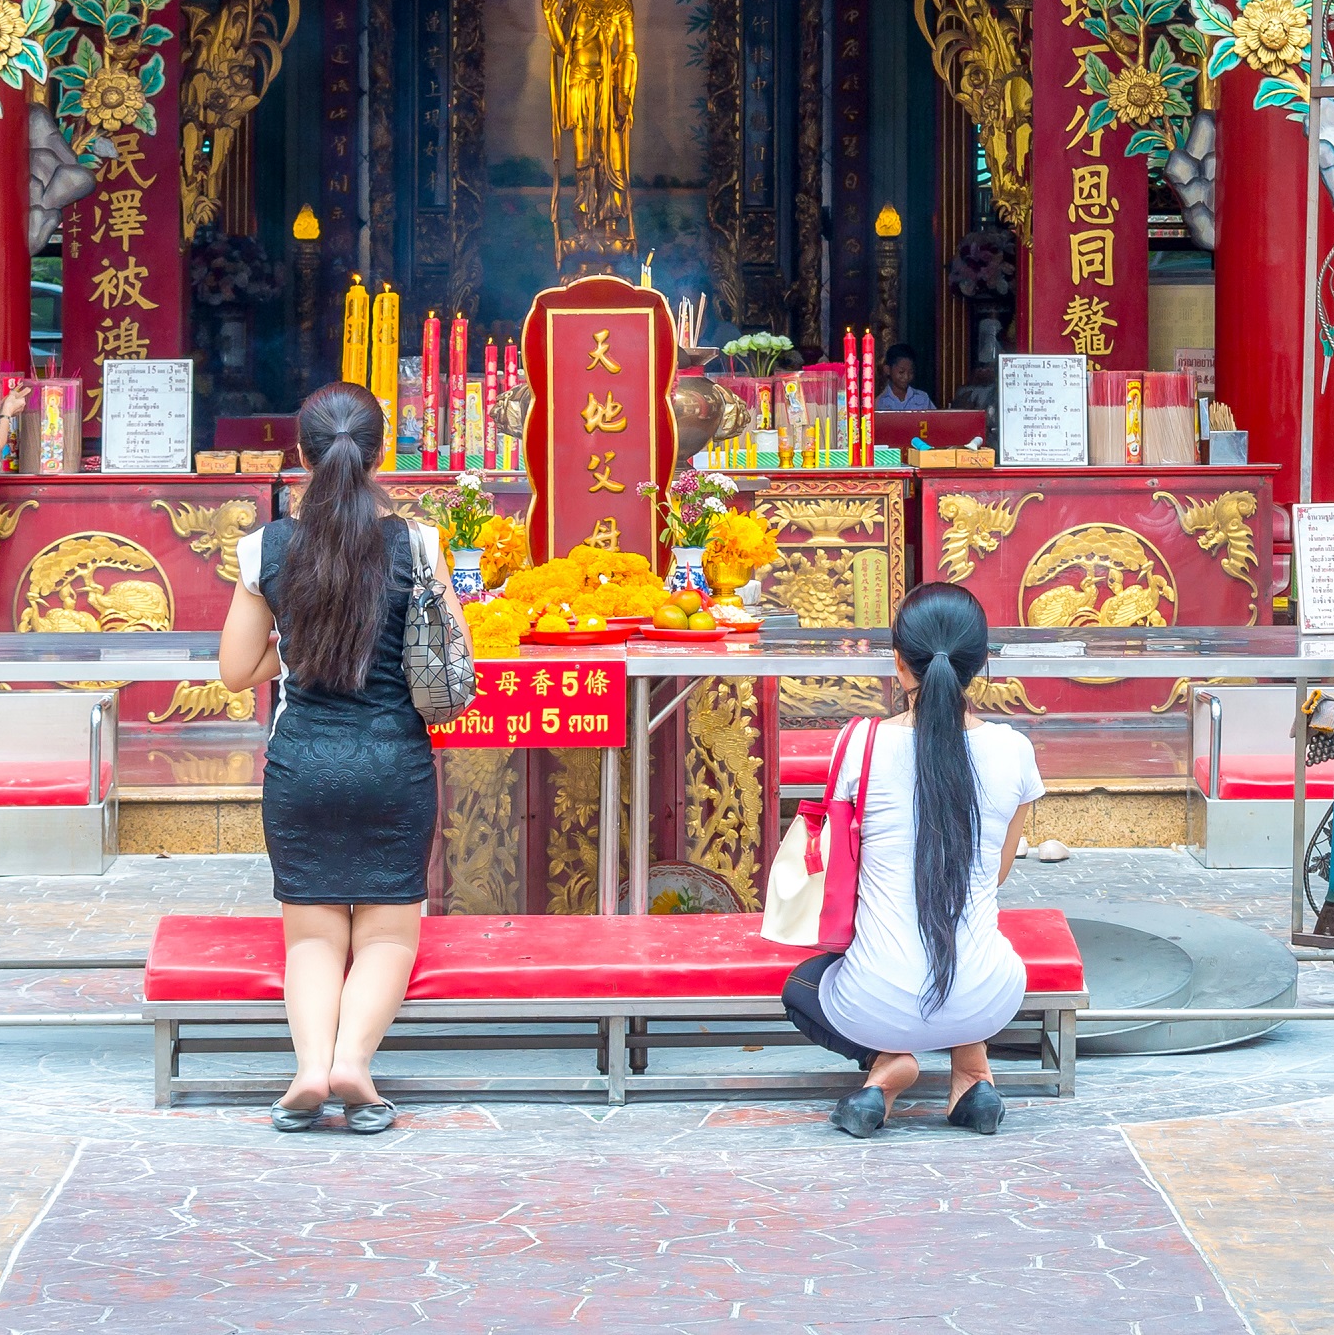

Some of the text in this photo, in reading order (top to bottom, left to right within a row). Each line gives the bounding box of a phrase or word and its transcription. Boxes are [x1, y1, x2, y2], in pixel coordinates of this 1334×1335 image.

[147, 365, 157, 374] 15
[1042, 361, 1051, 369] 15
[263, 423, 274, 442] 1
[507, 712, 531, 743] ธูป
[542, 708, 560, 733] 5
[568, 714, 609, 733] ดอก
